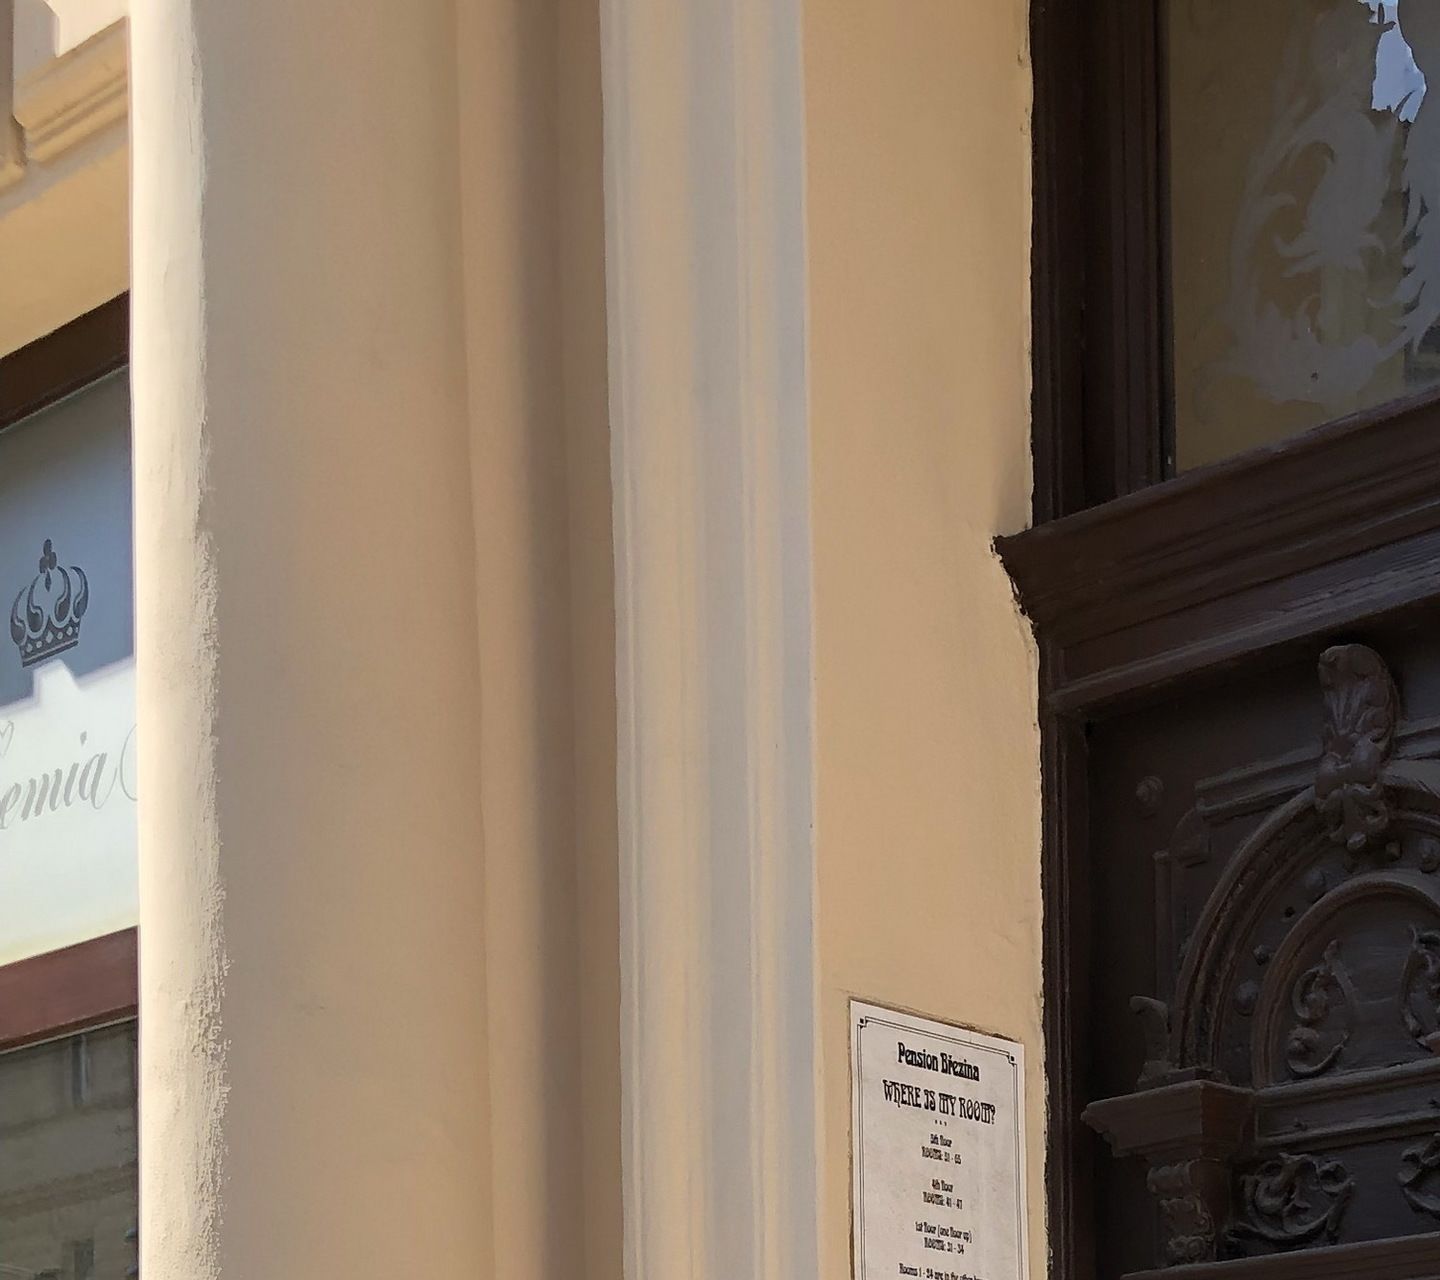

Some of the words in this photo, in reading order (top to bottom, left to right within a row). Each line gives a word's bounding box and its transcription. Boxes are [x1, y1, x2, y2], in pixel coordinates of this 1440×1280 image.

[897, 1042, 939, 1074] Pension
[940, 1052, 980, 1082] Březina
[924, 1089, 936, 1112] IS
[938, 1093, 956, 1117] MY
[959, 1097, 996, 1125] ROOM?
